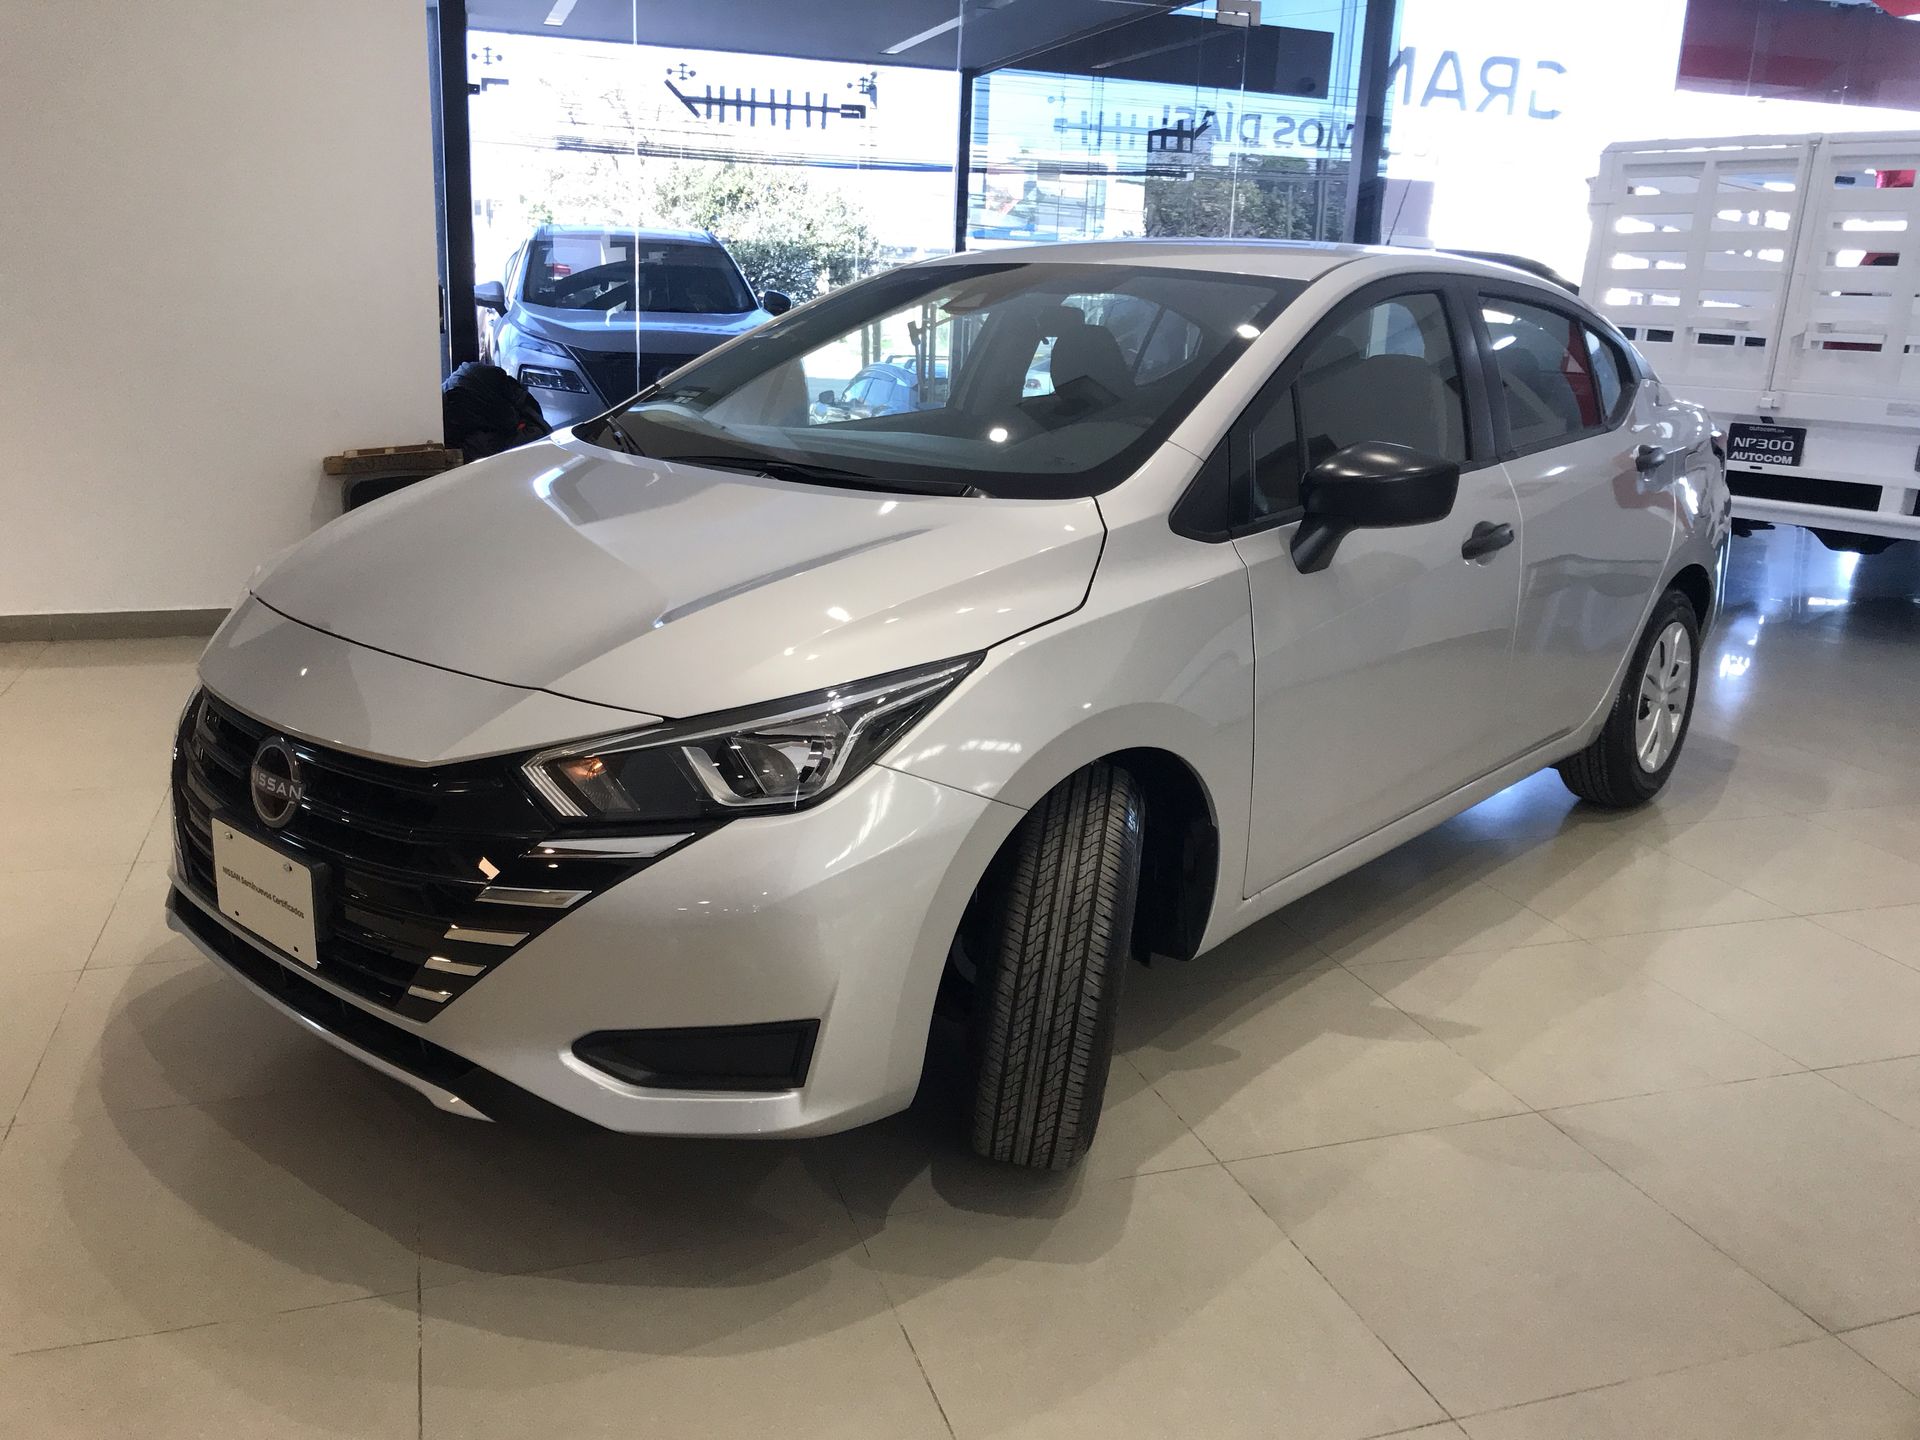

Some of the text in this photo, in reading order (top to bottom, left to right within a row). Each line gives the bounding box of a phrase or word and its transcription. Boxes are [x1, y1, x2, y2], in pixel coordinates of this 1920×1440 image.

[1733, 437, 1795, 451] NP300
[1730, 451, 1793, 465] AUTOCOM
[222, 866, 241, 882] NISSAN
